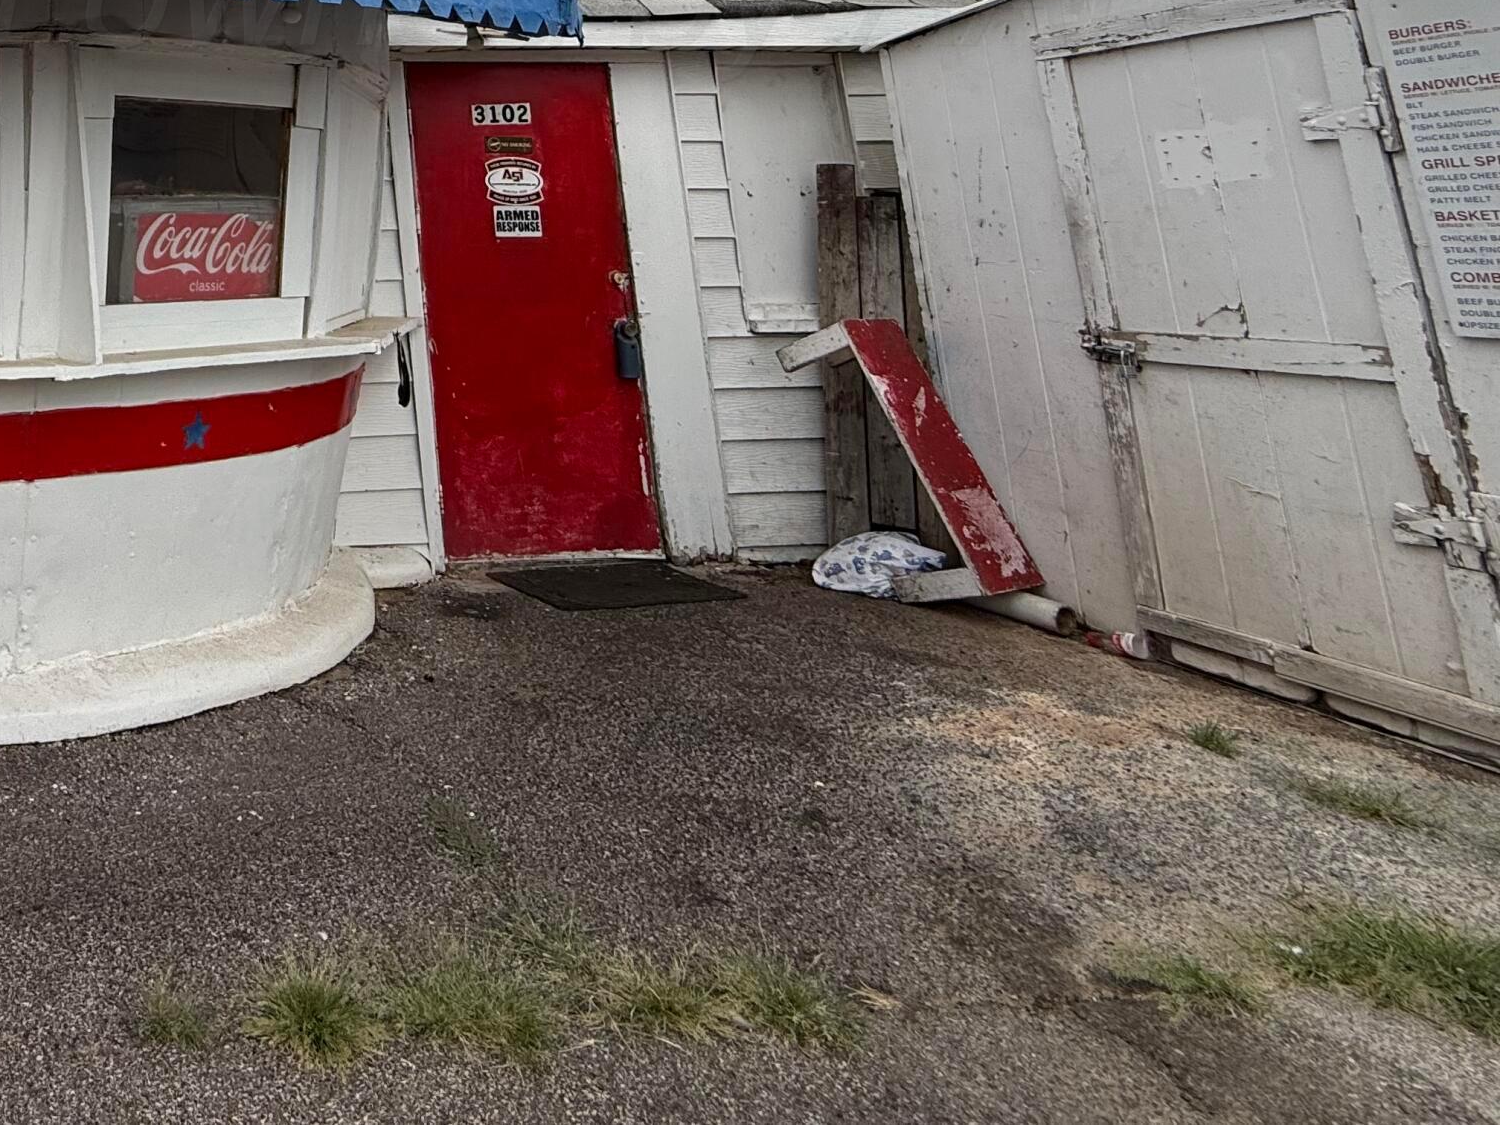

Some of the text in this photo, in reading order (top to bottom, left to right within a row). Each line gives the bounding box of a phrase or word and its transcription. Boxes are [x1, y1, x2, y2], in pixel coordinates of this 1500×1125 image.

[1388, 19, 1472, 40] BURGERS:
[1393, 40, 1462, 56] BEEF BURGER
[1395, 49, 1480, 66] DOUBLE BURGER
[1406, 101, 1423, 109] BLT
[474, 104, 529, 124] 3102
[1408, 106, 1499, 120] STEAK SANDWICH
[1411, 118, 1493, 131] FISH SANDWICH
[1414, 132, 1460, 142] CHICKEN
[1416, 145, 1440, 153] HAM
[1451, 141, 1493, 151] CHEESE
[1421, 157, 1470, 170] GRILL
[1424, 173, 1468, 182] GRILLED
[1427, 184, 1471, 193] GRILLED
[1430, 195, 1491, 204] PATTY MELT
[496, 210, 539, 221] ARMED
[1434, 209, 1500, 222] BASKET
[496, 221, 541, 233] RESPONSE
[136, 212, 275, 275] Coca-Cola
[1440, 234, 1487, 243] CHICKEN
[1443, 246, 1477, 254] STEAK
[1446, 258, 1495, 266] CHICKEN
[189, 279, 225, 292] classic
[1457, 297, 1483, 306] BEEF
